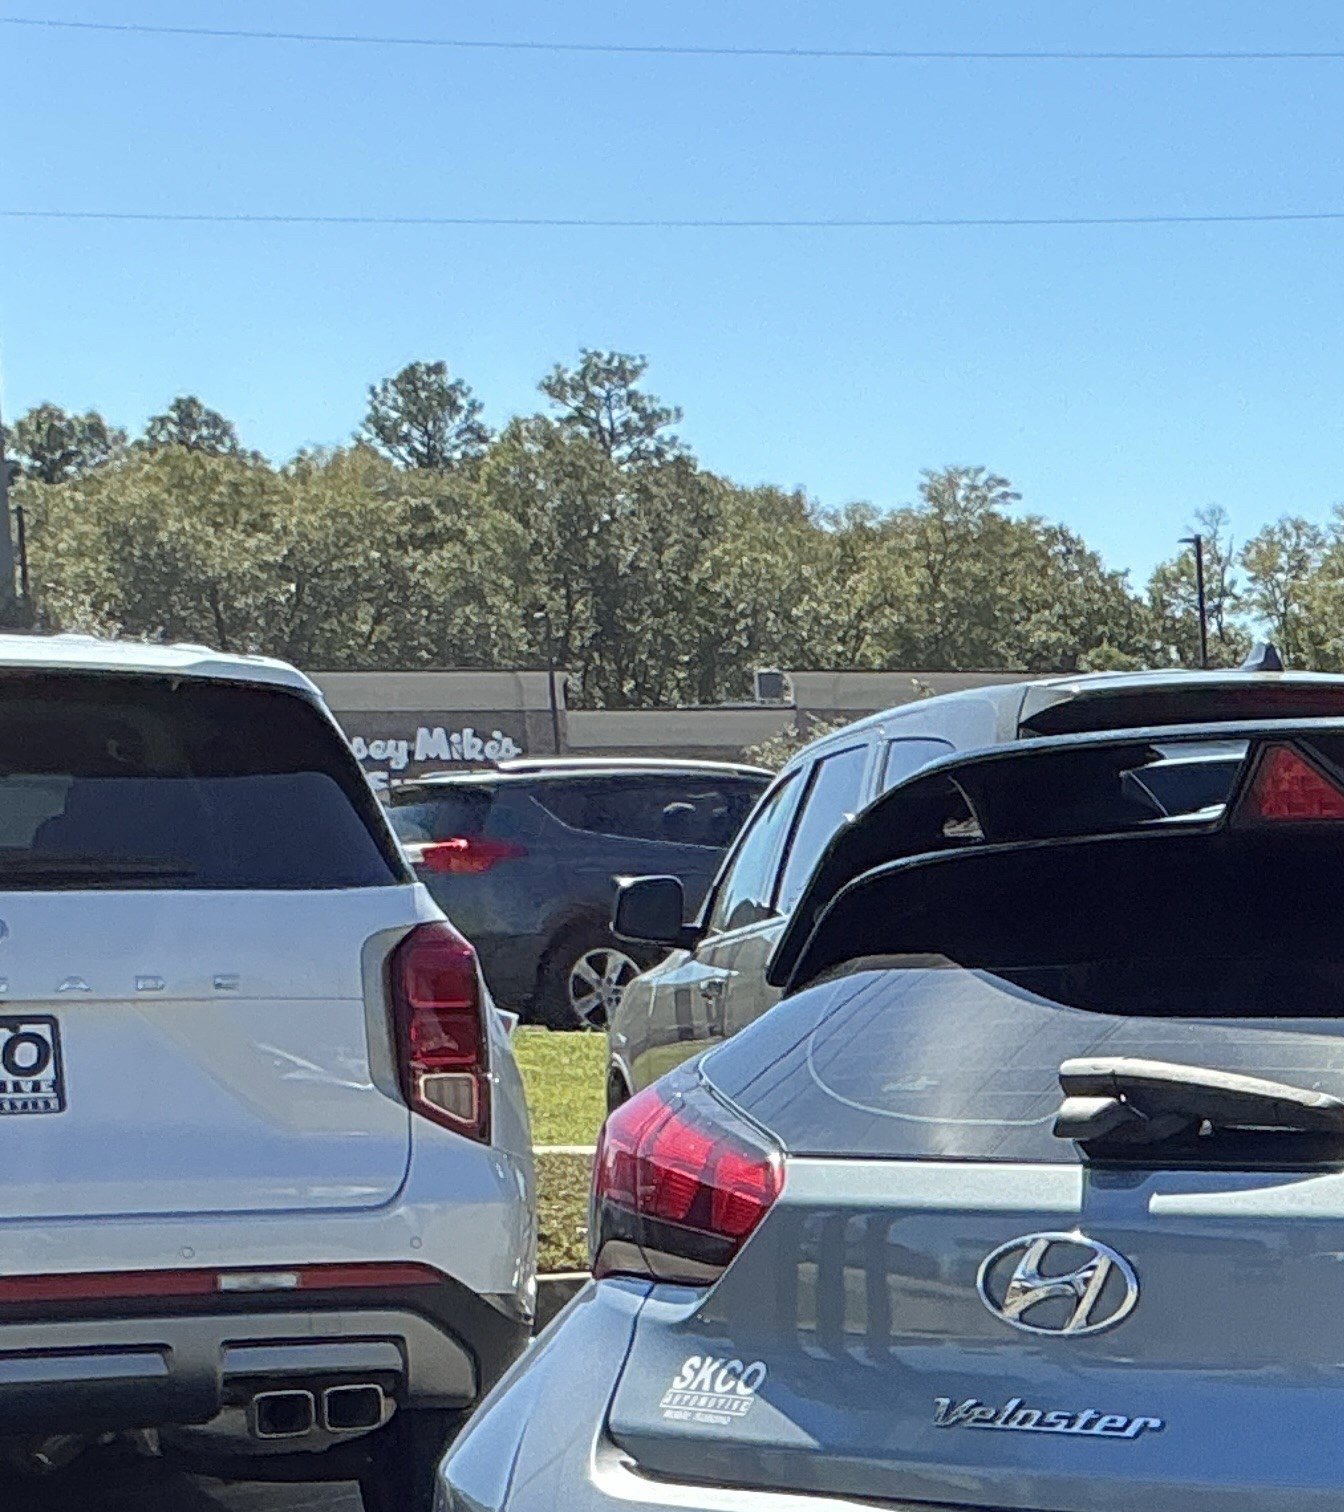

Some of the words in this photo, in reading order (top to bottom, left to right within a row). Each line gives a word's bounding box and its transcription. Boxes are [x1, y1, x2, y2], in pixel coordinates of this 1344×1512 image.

[414, 726, 523, 762] Mike's
[672, 1355, 766, 1395] SKCO
[934, 1397, 1163, 1439] Veloster
